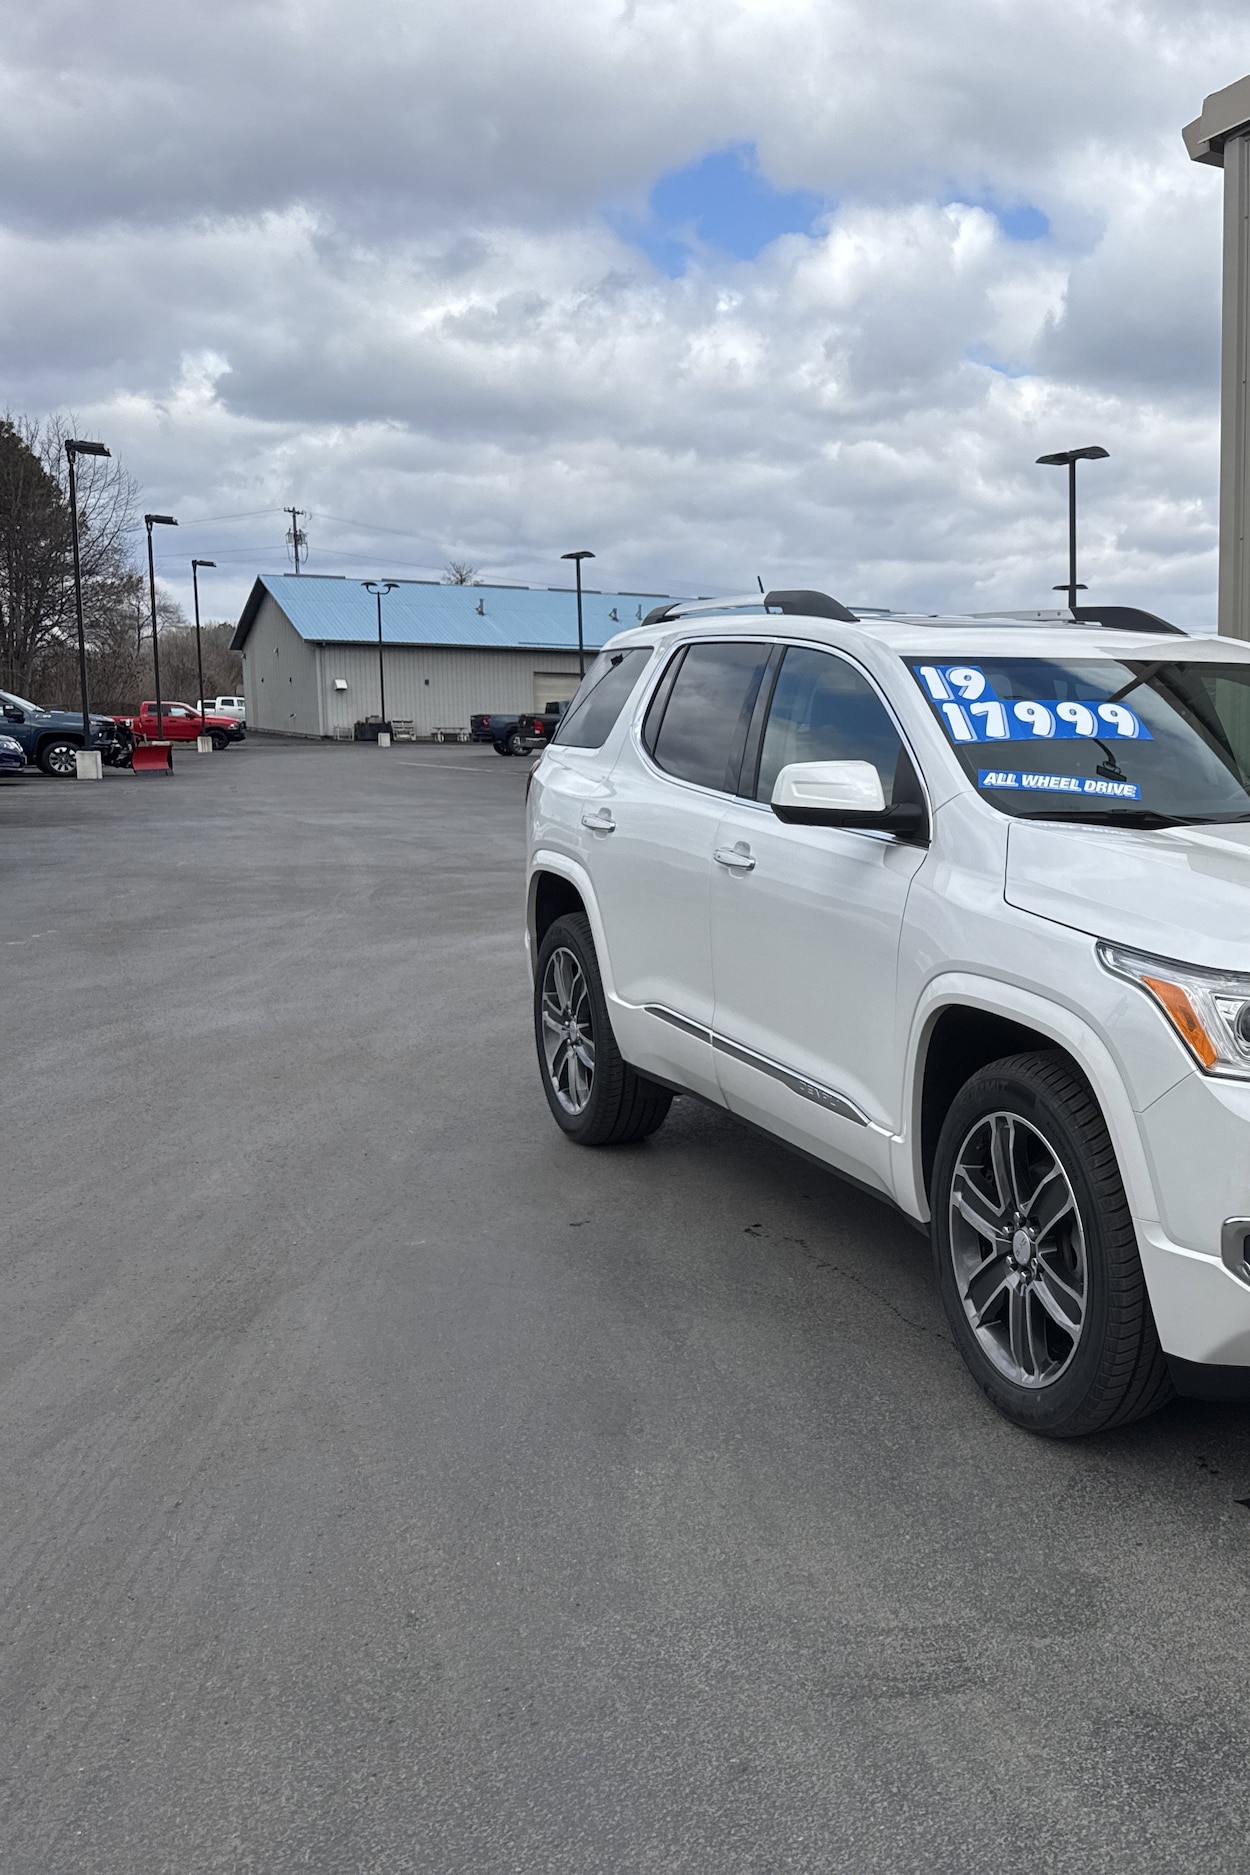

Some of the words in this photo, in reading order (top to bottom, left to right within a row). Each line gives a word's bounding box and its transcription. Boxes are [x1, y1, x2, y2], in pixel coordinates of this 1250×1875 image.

[920, 666, 986, 701] 19
[942, 701, 1140, 741] 17999
[983, 772, 1019, 787] ALL
[1021, 774, 1082, 792] WHEEL
[1084, 780, 1137, 798] DRIVE
